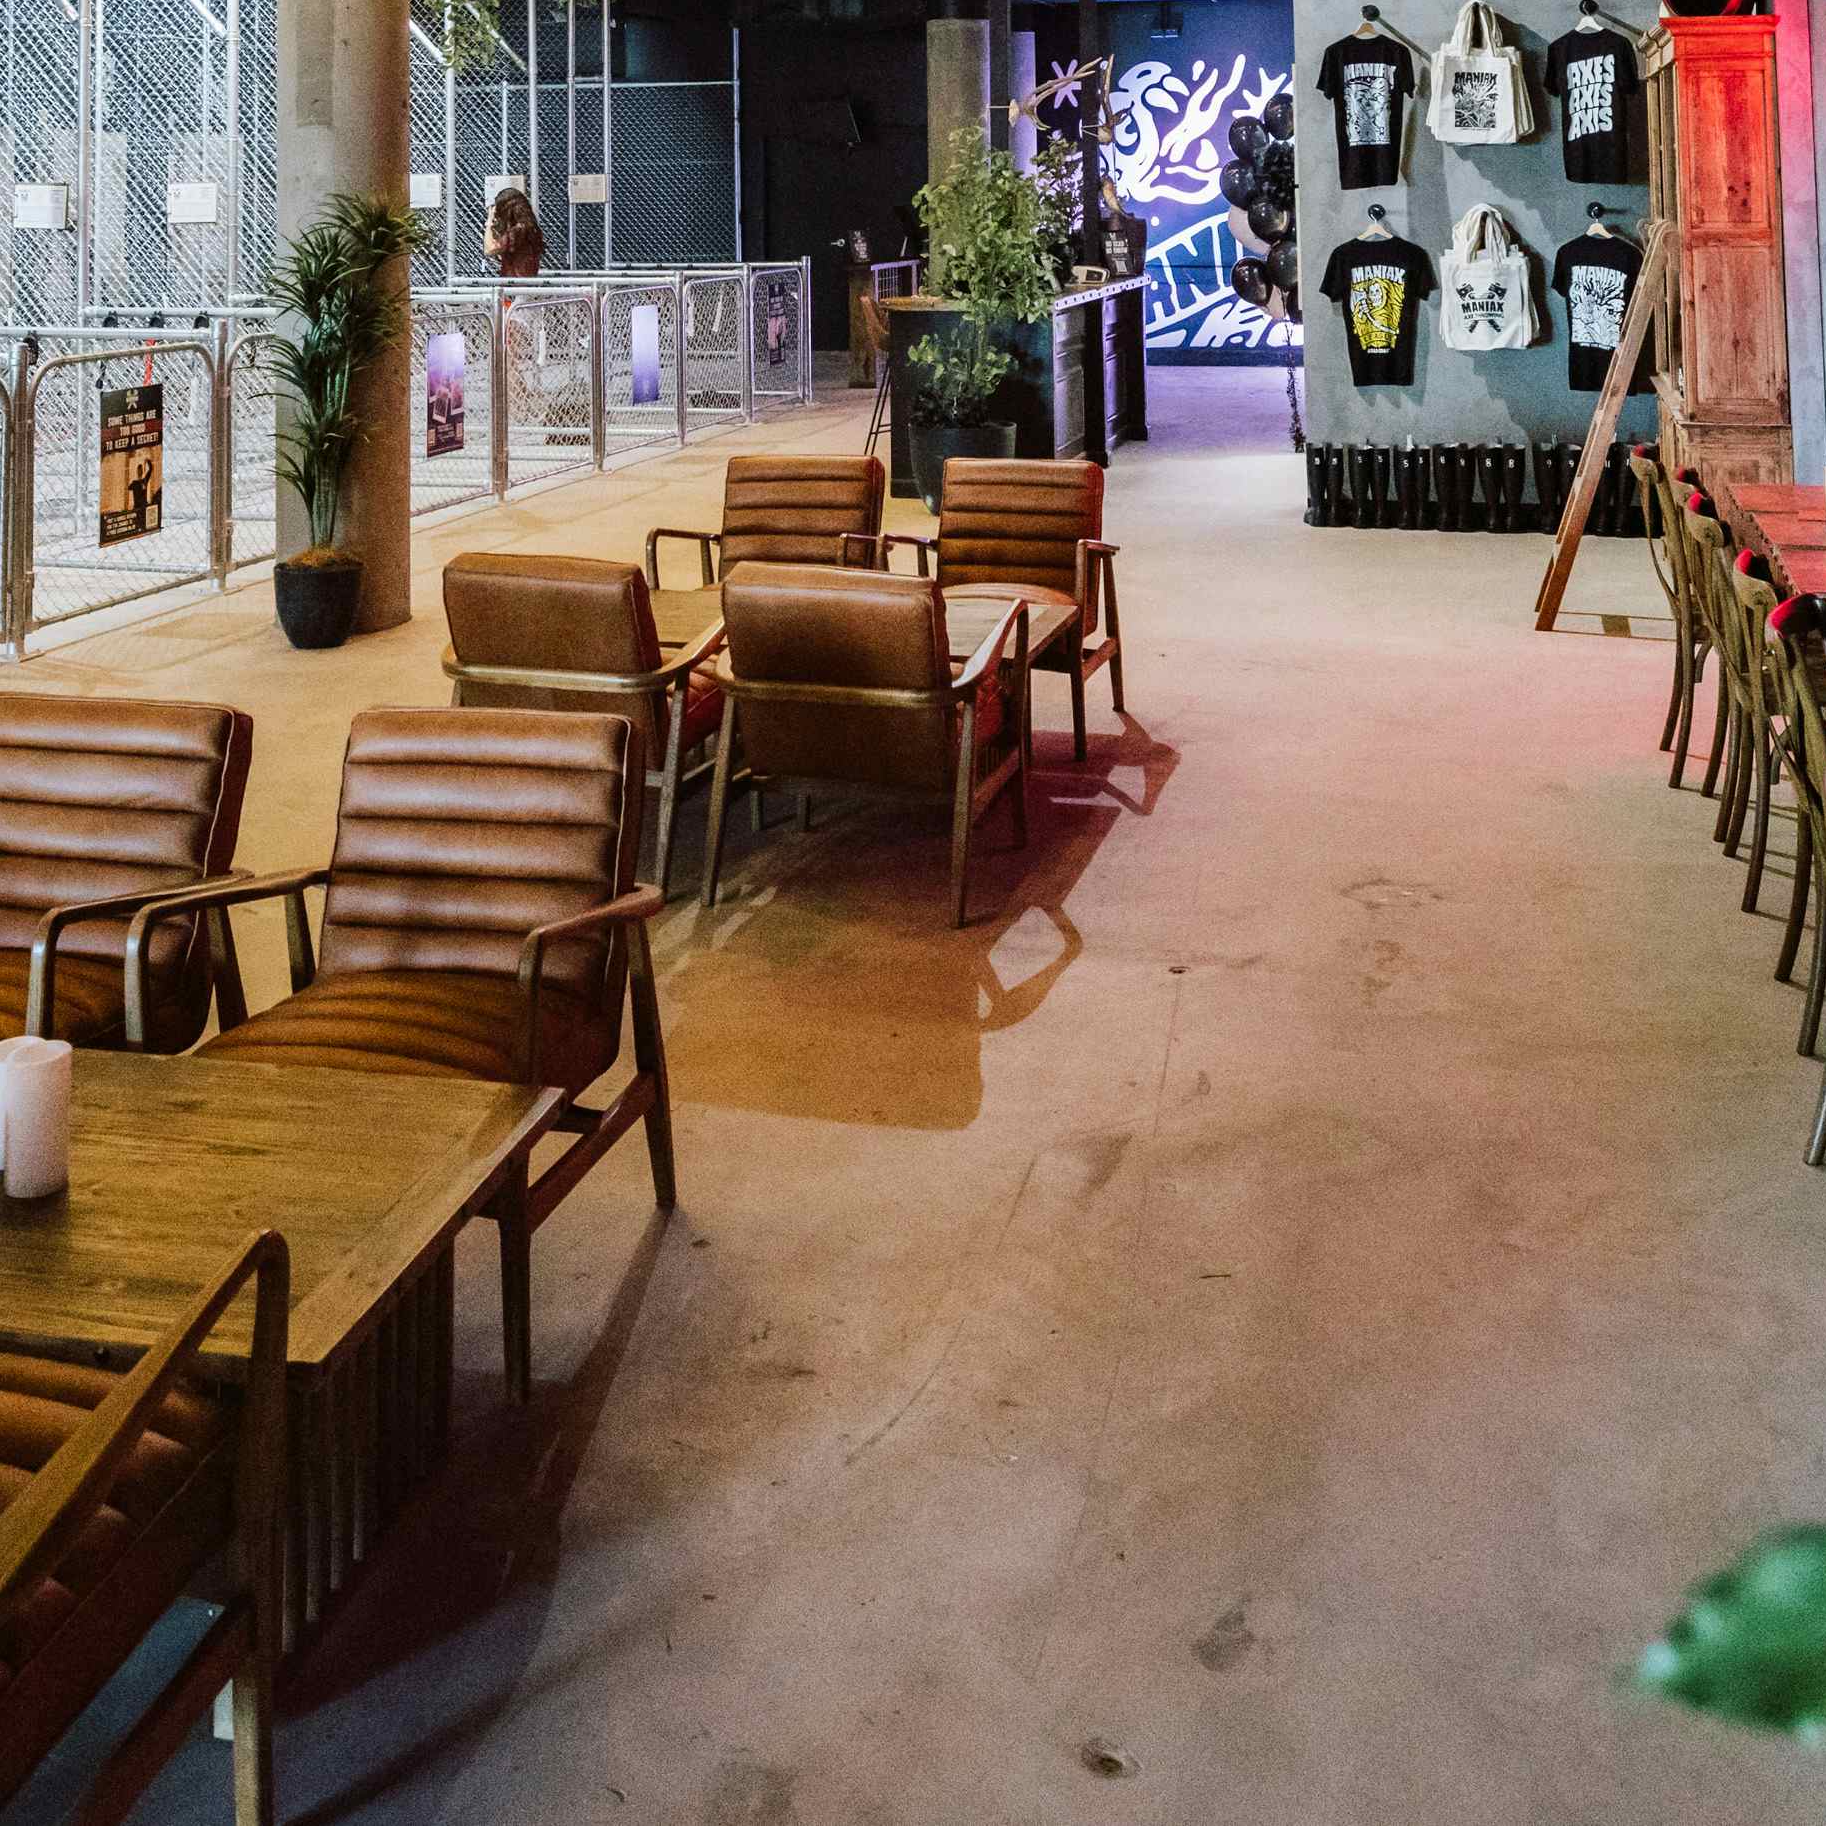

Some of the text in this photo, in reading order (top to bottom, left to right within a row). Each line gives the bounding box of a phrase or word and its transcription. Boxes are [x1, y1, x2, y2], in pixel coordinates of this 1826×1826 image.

[1454, 72, 1498, 86] MANIAX
[1566, 54, 1615, 90] AXES
[1568, 83, 1614, 115] AXIS
[1567, 106, 1613, 142] AXIS
[1351, 265, 1406, 285] MANIAX
[1461, 301, 1505, 313] MANIAX
[108, 409, 156, 427] SOME THINGS ARE
[120, 423, 146, 436] TOO GOOD
[106, 440, 113, 451] TO
[115, 438, 129, 449] KEEP
[131, 436, 135, 446] A
